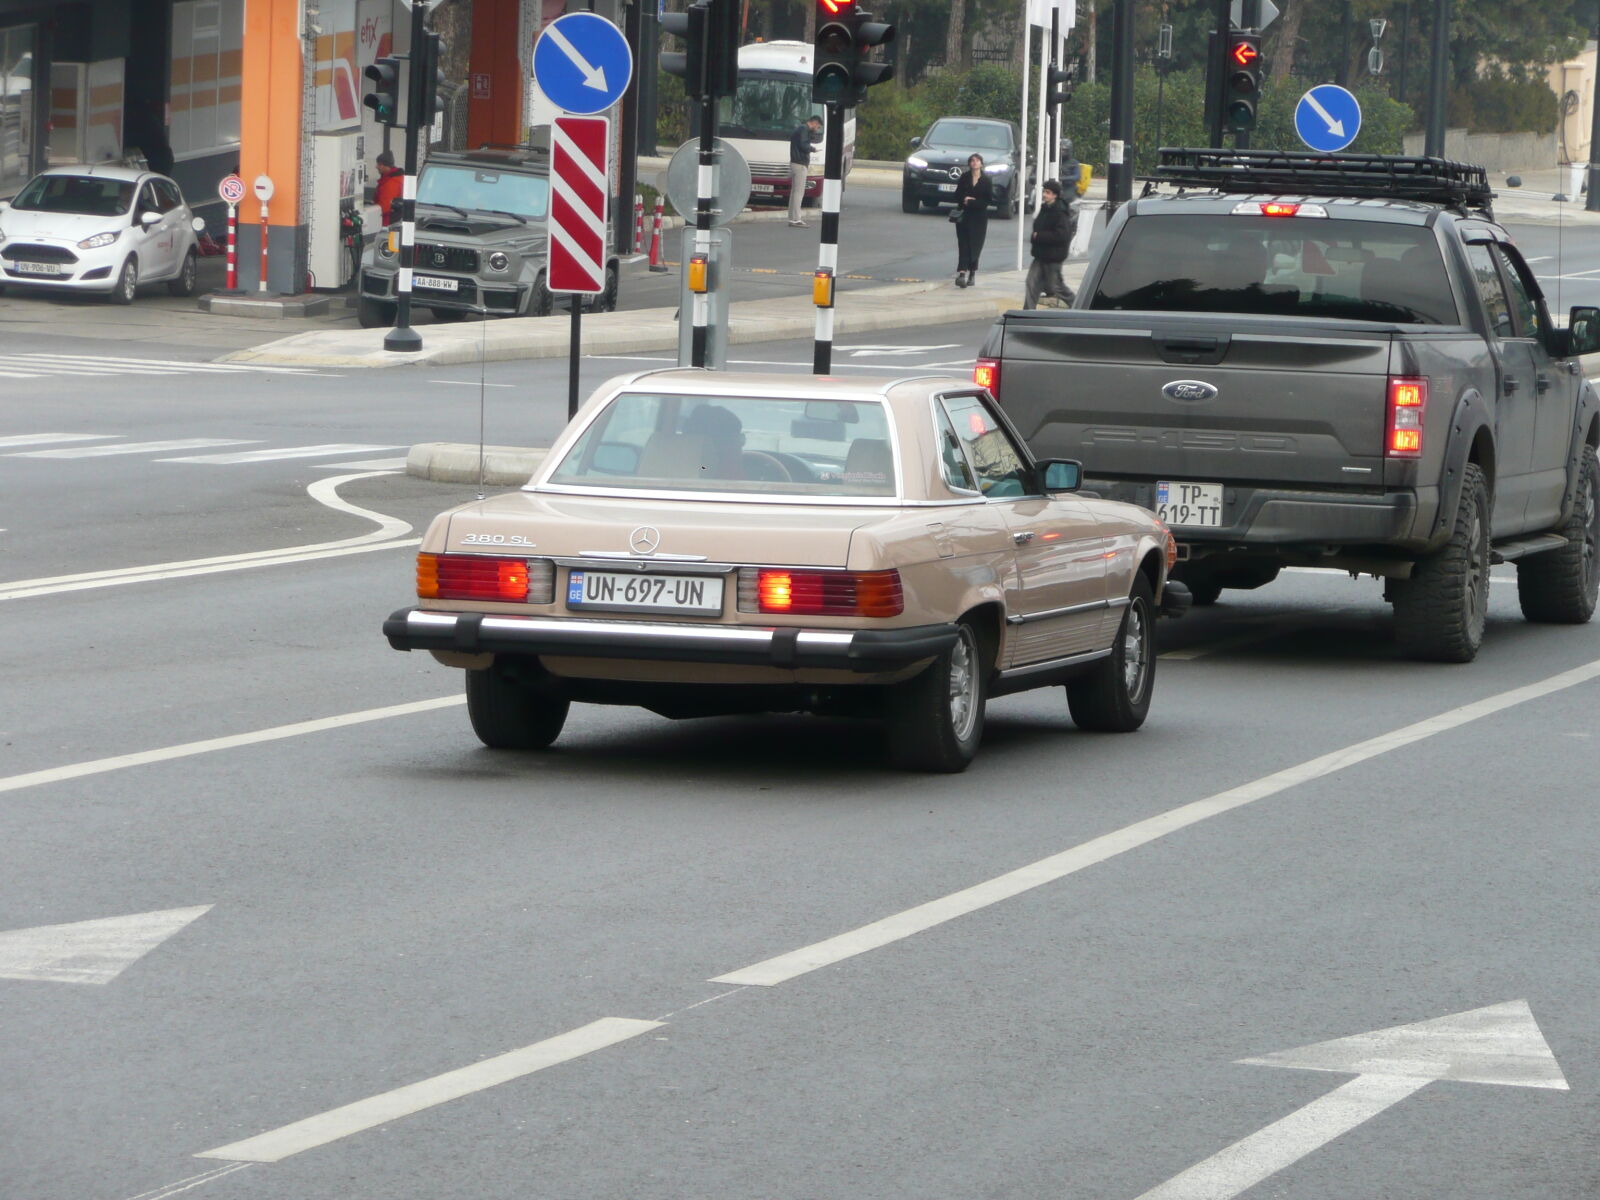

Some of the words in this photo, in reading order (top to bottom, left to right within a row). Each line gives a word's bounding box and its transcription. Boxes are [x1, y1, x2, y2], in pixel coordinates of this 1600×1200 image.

[1174, 384, 1206, 399] Ford
[1180, 485, 1208, 505] TP-
[1158, 504, 1220, 525] 619-TT
[464, 533, 505, 545] 380
[510, 535, 533, 545] SL
[569, 589, 583, 600] GE
[586, 575, 705, 606] UN-697-UN
